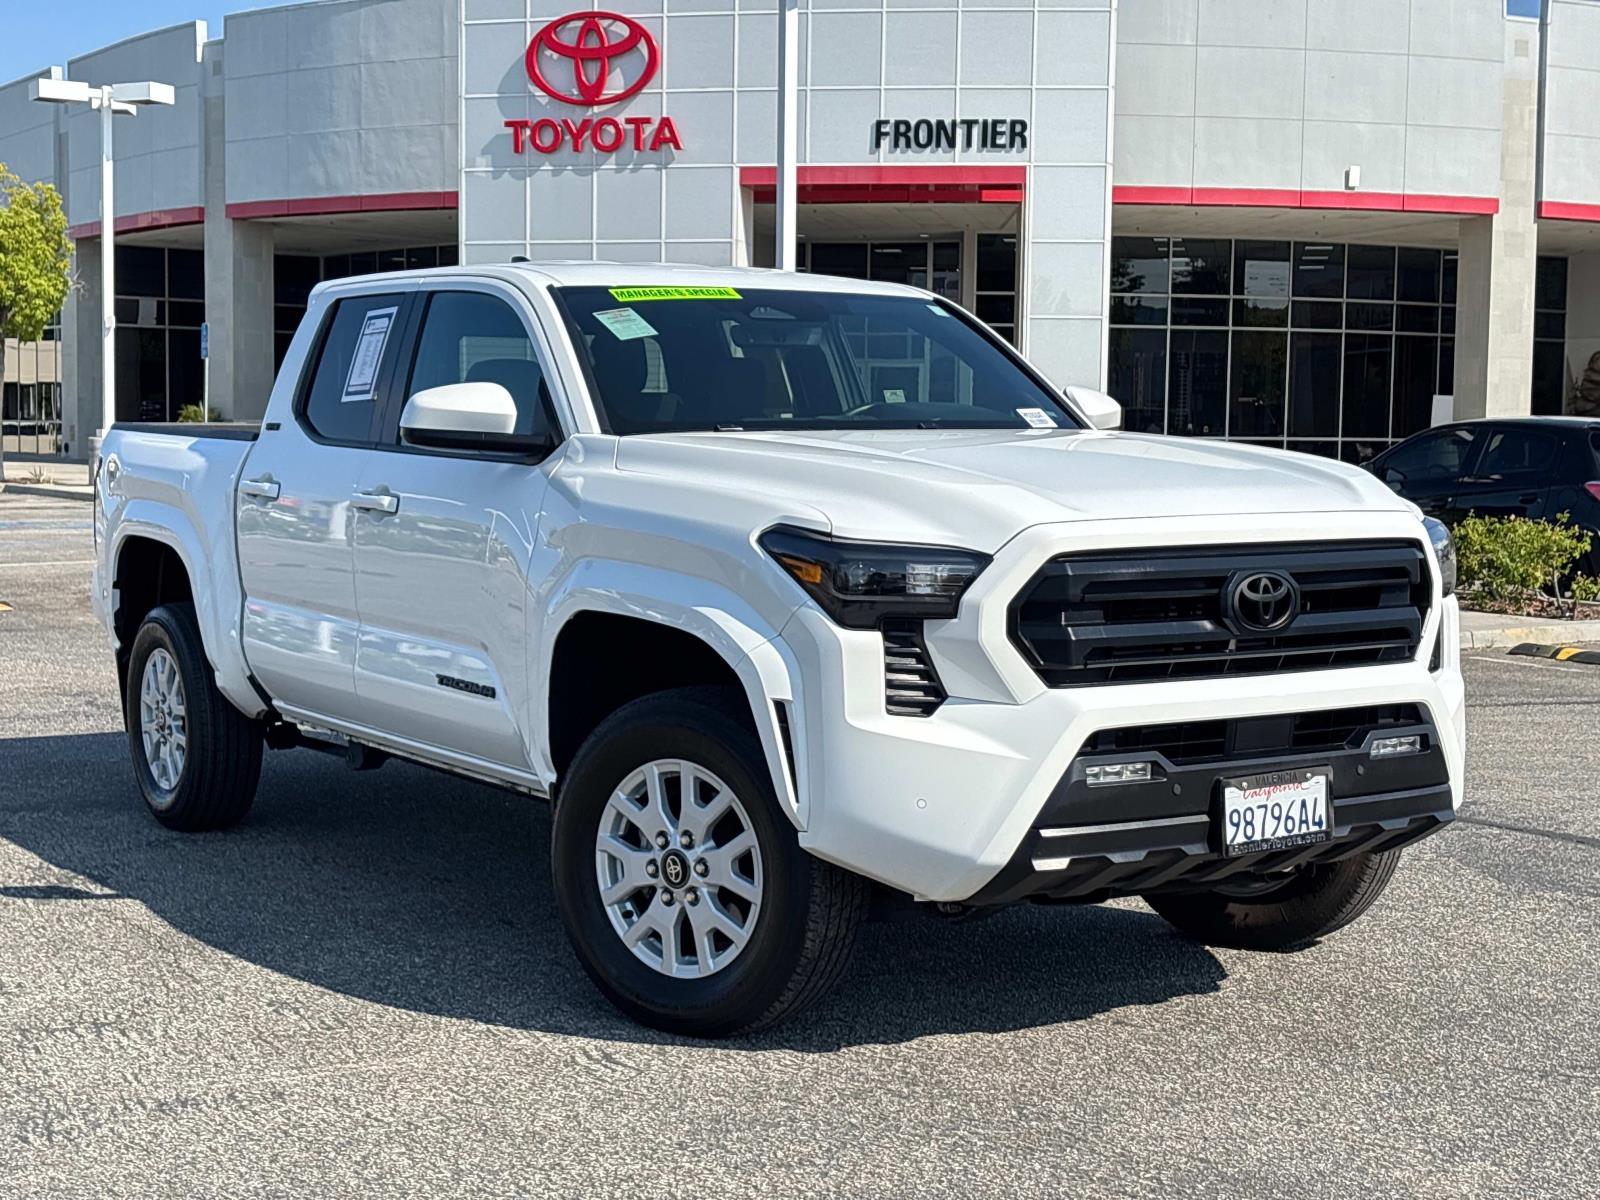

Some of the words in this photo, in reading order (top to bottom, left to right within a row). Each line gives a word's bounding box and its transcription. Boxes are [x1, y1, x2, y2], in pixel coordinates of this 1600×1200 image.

[504, 116, 683, 154] TOYOTA
[874, 118, 1028, 151] FRONTIER
[614, 288, 683, 300] MANAGER'S
[686, 287, 733, 298] SPECIAL
[1255, 771, 1298, 786] VALENCIA
[1228, 796, 1324, 845] 98796A4
